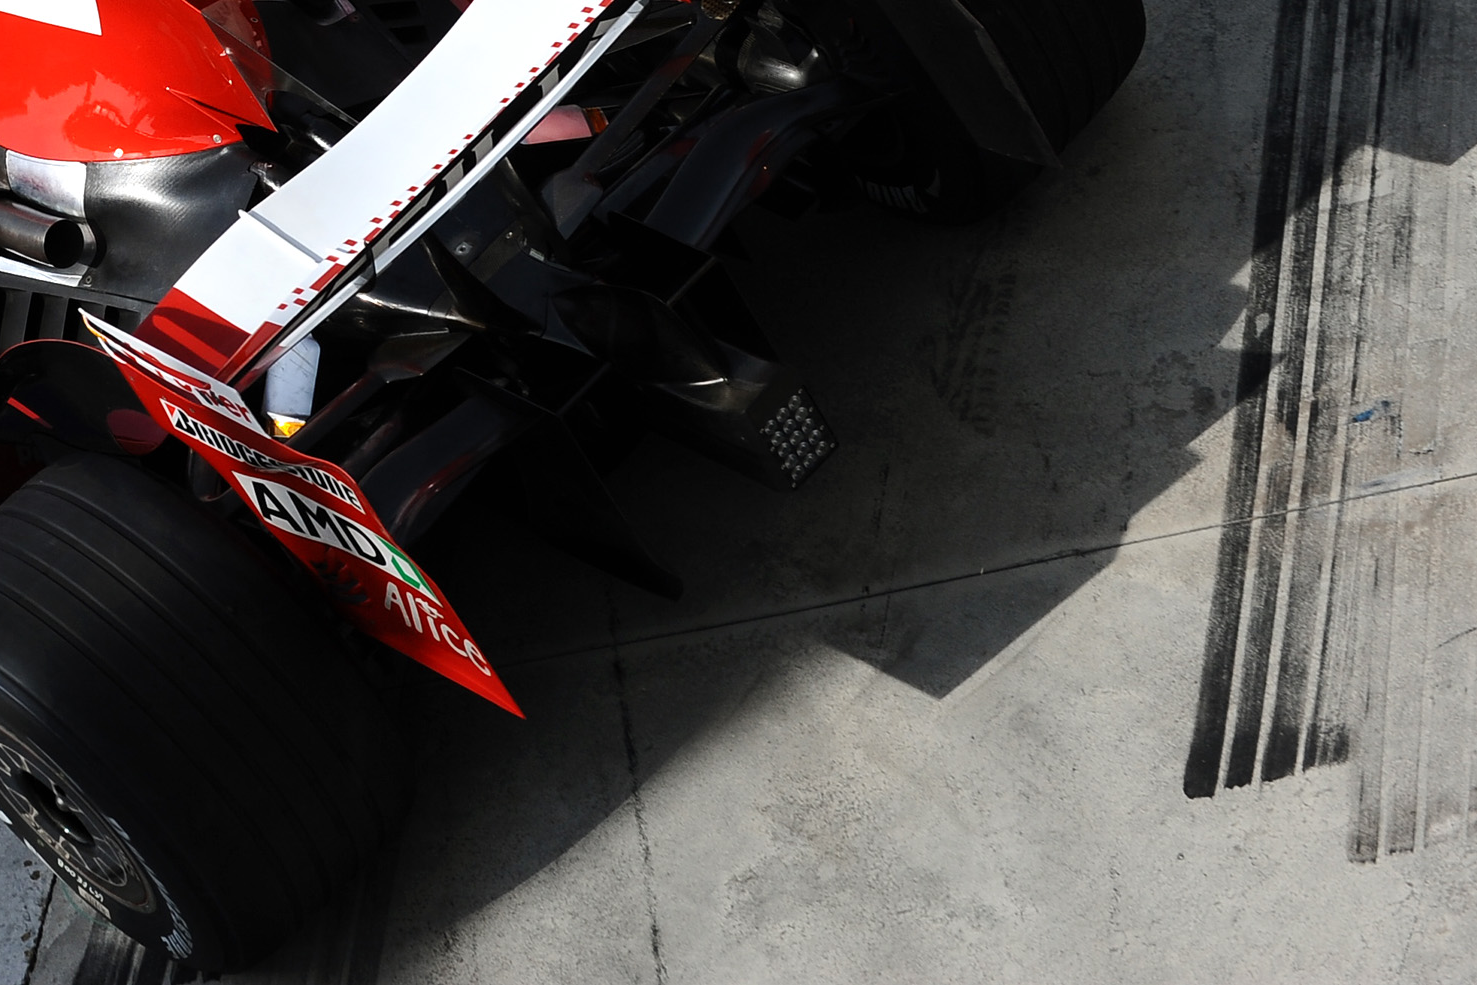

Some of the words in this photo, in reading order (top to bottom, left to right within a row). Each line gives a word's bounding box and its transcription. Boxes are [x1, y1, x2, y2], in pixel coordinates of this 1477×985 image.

[175, 411, 362, 510] BRIDGESTONE
[251, 481, 387, 566] AMD
[384, 582, 491, 676] Alice
